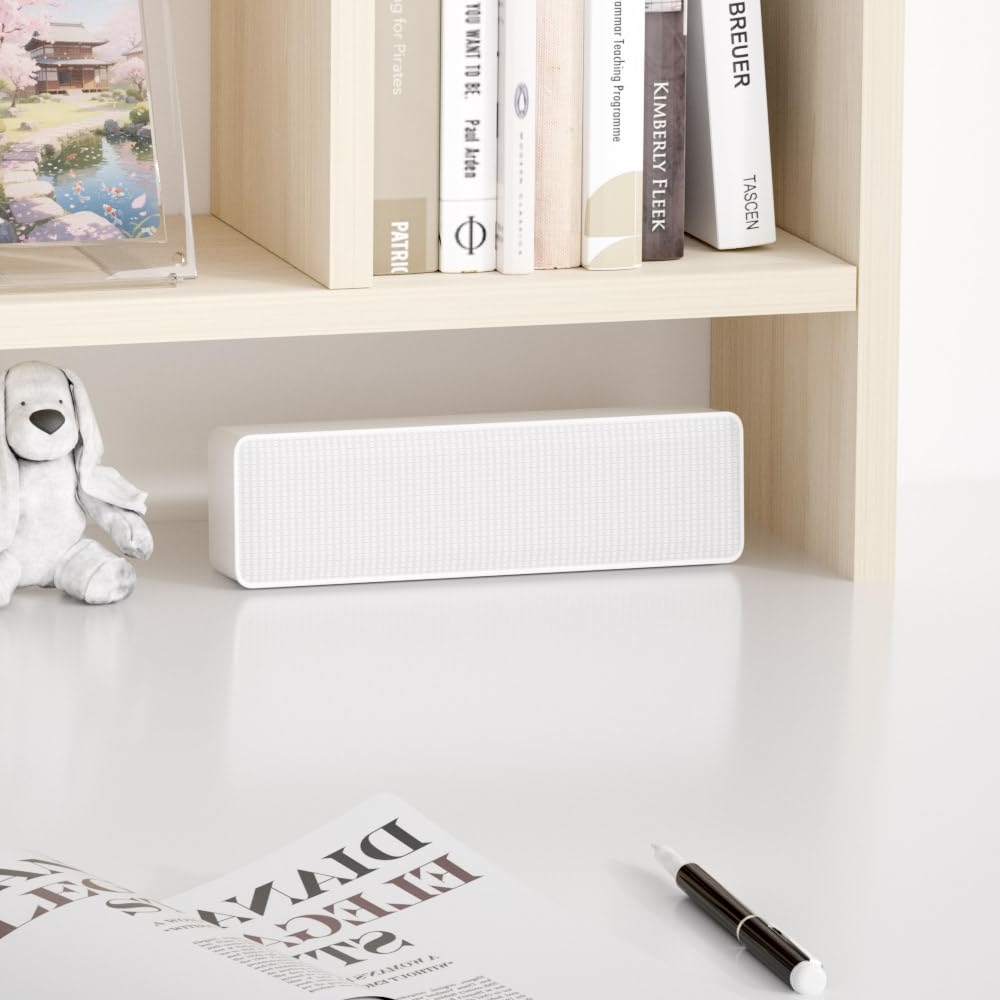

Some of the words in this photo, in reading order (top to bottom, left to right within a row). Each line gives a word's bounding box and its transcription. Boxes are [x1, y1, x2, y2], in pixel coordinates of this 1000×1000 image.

[392, 18, 406, 39] for
[465, 3, 481, 25] YOU
[465, 29, 481, 59] WANT
[611, 39, 625, 82] Teaching
[728, 2, 751, 89] BREUER
[391, 44, 406, 96] Pirates
[465, 65, 481, 78] TO
[465, 82, 481, 100] BE.
[465, 120, 481, 143] Paul
[610, 85, 624, 142] Programme
[652, 81, 669, 172] KIMBERLY
[464, 147, 481, 179] Arden
[651, 178, 668, 232] FLEEK
[743, 174, 760, 230] TASCEN
